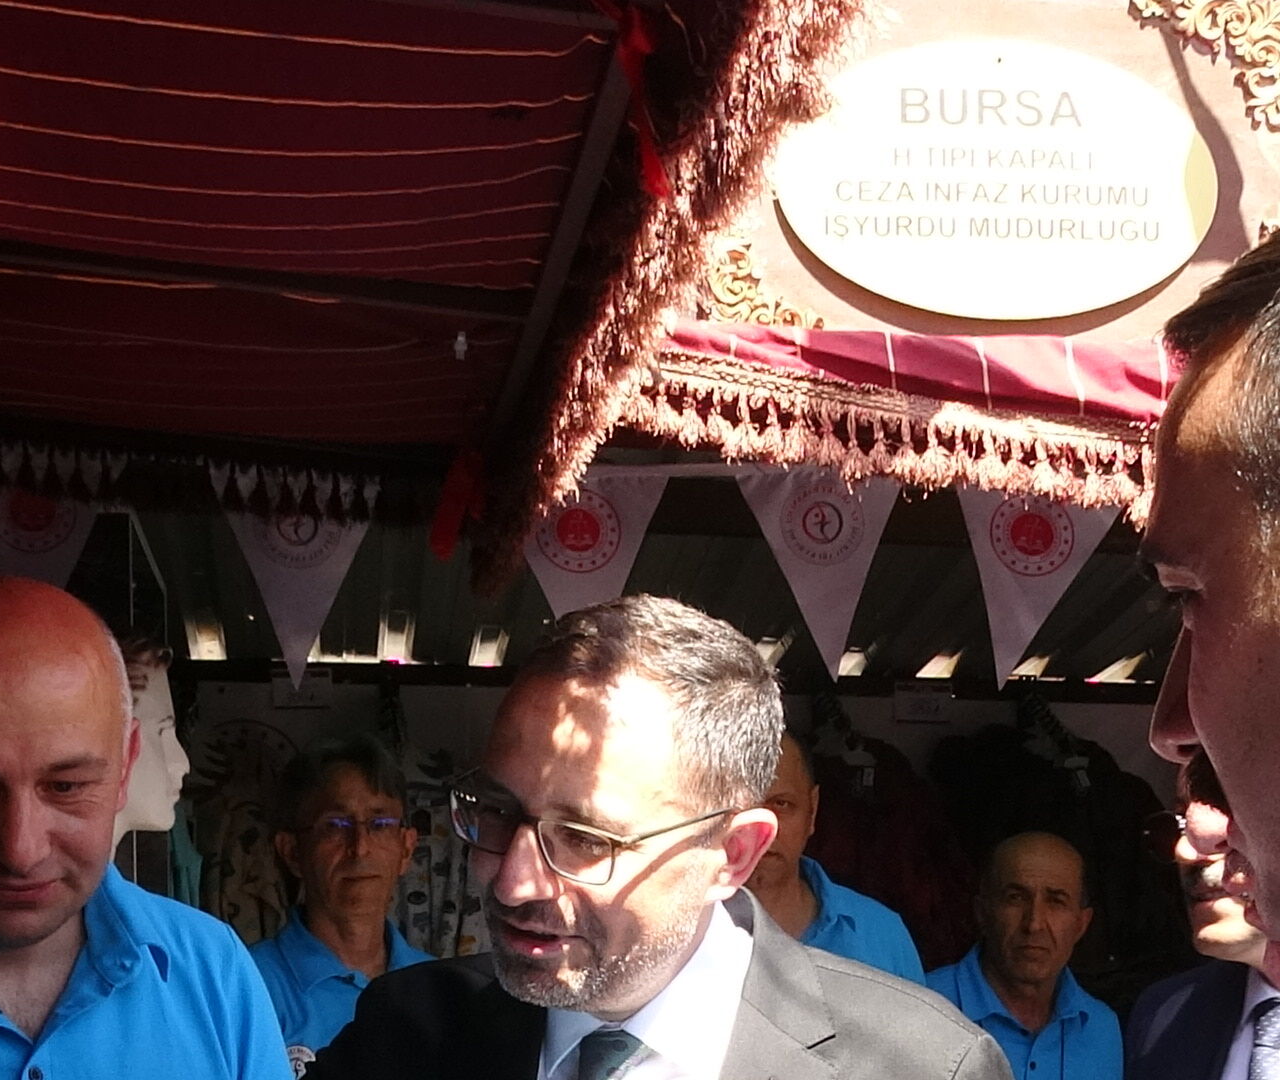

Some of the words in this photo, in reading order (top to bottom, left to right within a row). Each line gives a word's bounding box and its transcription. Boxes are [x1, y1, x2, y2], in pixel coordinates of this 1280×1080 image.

[899, 86, 1083, 128] BURSA
[892, 147, 911, 168] H
[986, 148, 1094, 172] KAPALI
[834, 179, 915, 203] CEZA
[1020, 183, 1150, 208] KURUMU
